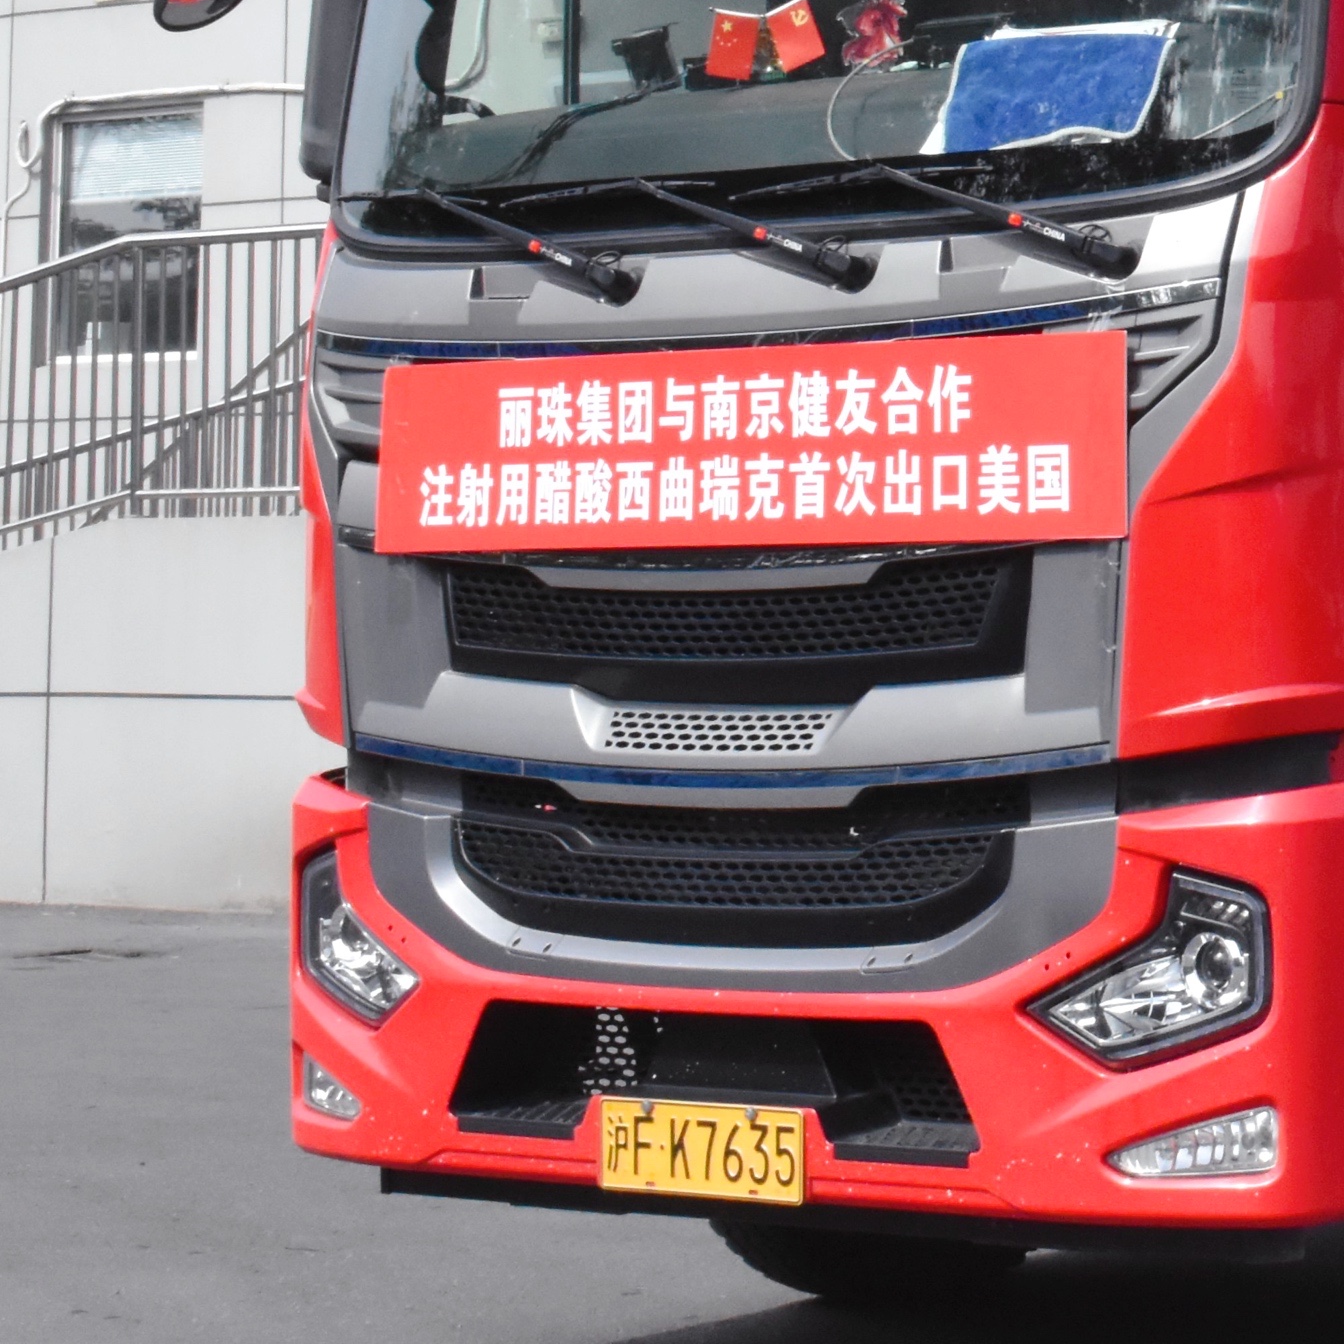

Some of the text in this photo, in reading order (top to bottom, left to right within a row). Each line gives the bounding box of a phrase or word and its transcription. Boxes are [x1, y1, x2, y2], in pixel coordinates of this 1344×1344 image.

[498, 364, 973, 449] 丽珠集团与南京健友合作
[419, 443, 1072, 529] 注射用醋酸西曲瑞克首次出口美国
